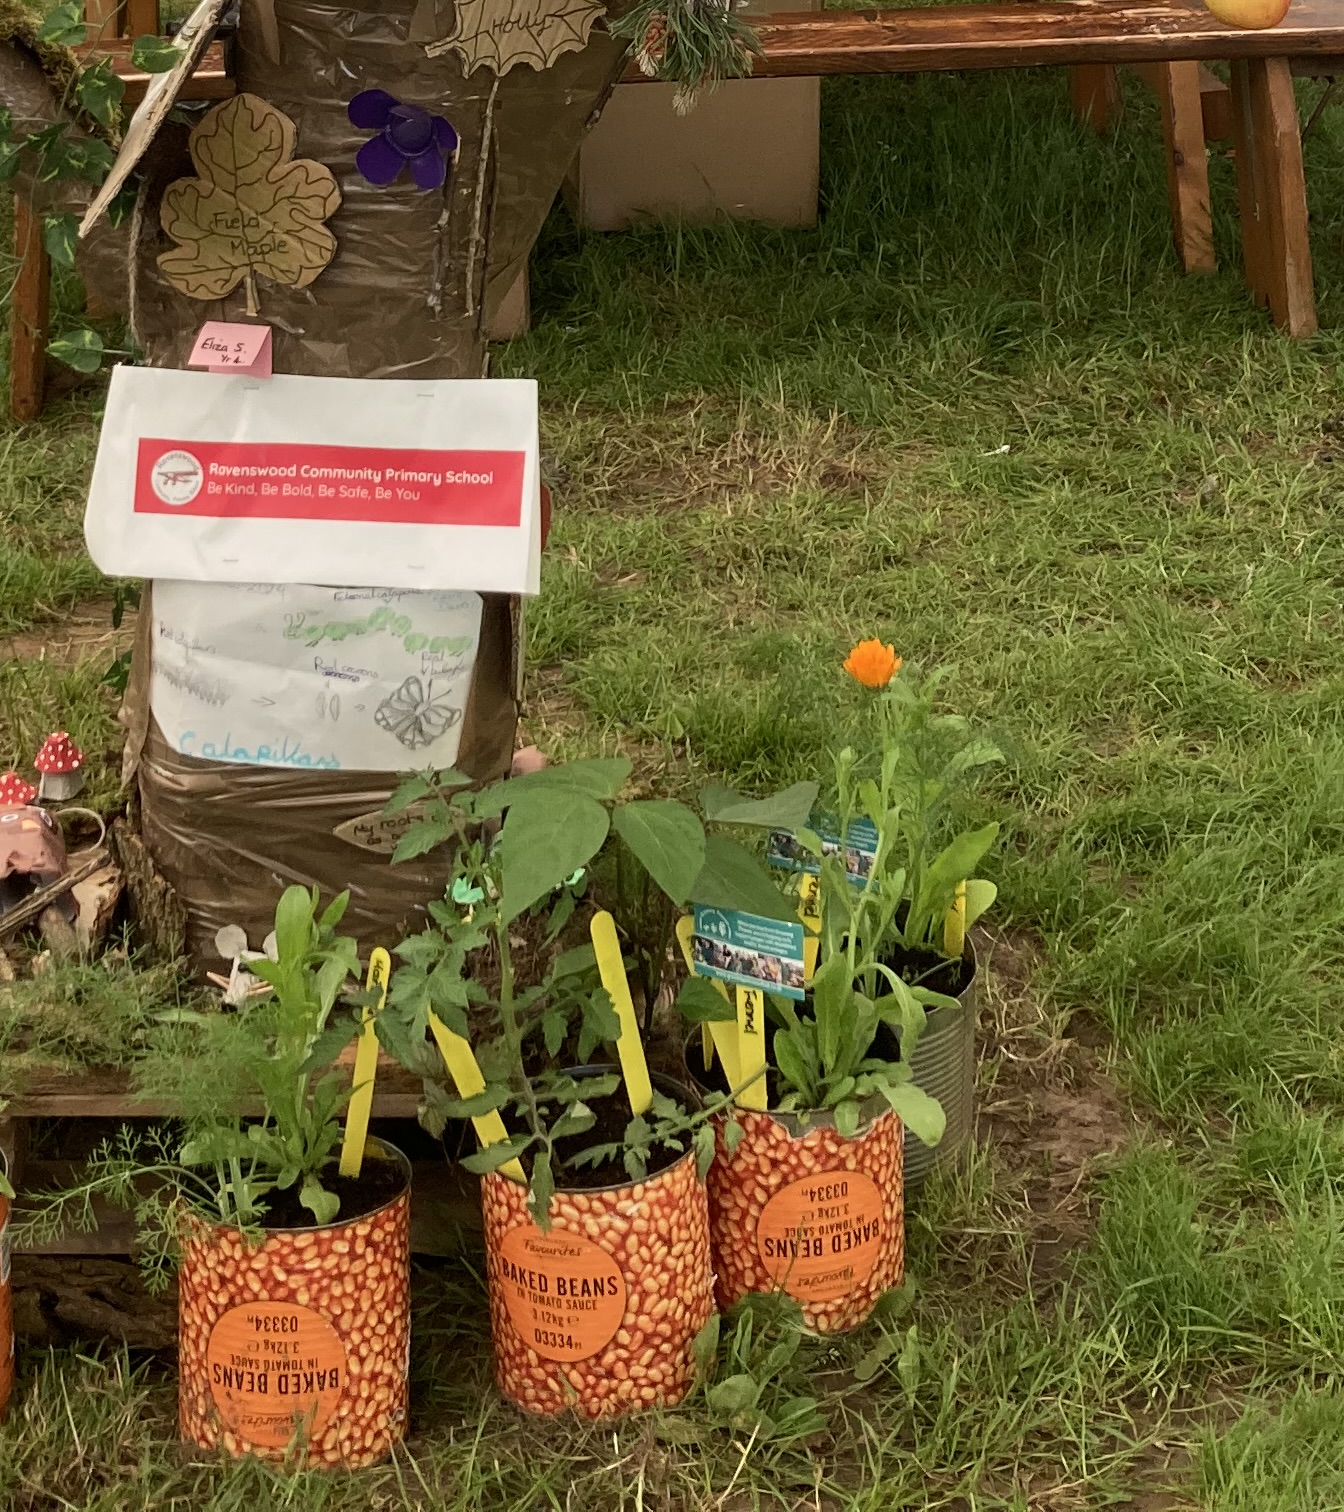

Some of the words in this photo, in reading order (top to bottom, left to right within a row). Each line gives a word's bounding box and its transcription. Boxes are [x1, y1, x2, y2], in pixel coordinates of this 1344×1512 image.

[200, 337, 229, 354] Eliza
[209, 462, 297, 478] Ravenswood
[301, 465, 382, 484] Community
[385, 468, 443, 487] Primary
[446, 470, 494, 485] School
[207, 481, 223, 495] Be
[224, 481, 259, 497] Kind,
[261, 483, 280, 496] Be
[282, 483, 316, 499] Bold,
[318, 485, 336, 497] Be
[338, 485, 373, 502] Safe,
[374, 487, 393, 500] Be
[395, 488, 421, 501] You
[809, 1181, 848, 1203] 03334
[818, 1218, 853, 1235] TOMATO
[831, 1216, 880, 1254] BAKED
[523, 1238, 583, 1257] Favourites
[764, 1236, 824, 1259] BEANS
[501, 1257, 549, 1294] BAKED
[556, 1275, 618, 1298] BEANS
[528, 1290, 563, 1309] TOMATO
[566, 1299, 598, 1311] SAUCE
[254, 1315, 299, 1333] 03334
[534, 1328, 574, 1350] 03334
[263, 1358, 304, 1373] TOMATO
[307, 1356, 319, 1370] IN
[212, 1362, 269, 1395] BEANS
[276, 1366, 340, 1395] BAKED
